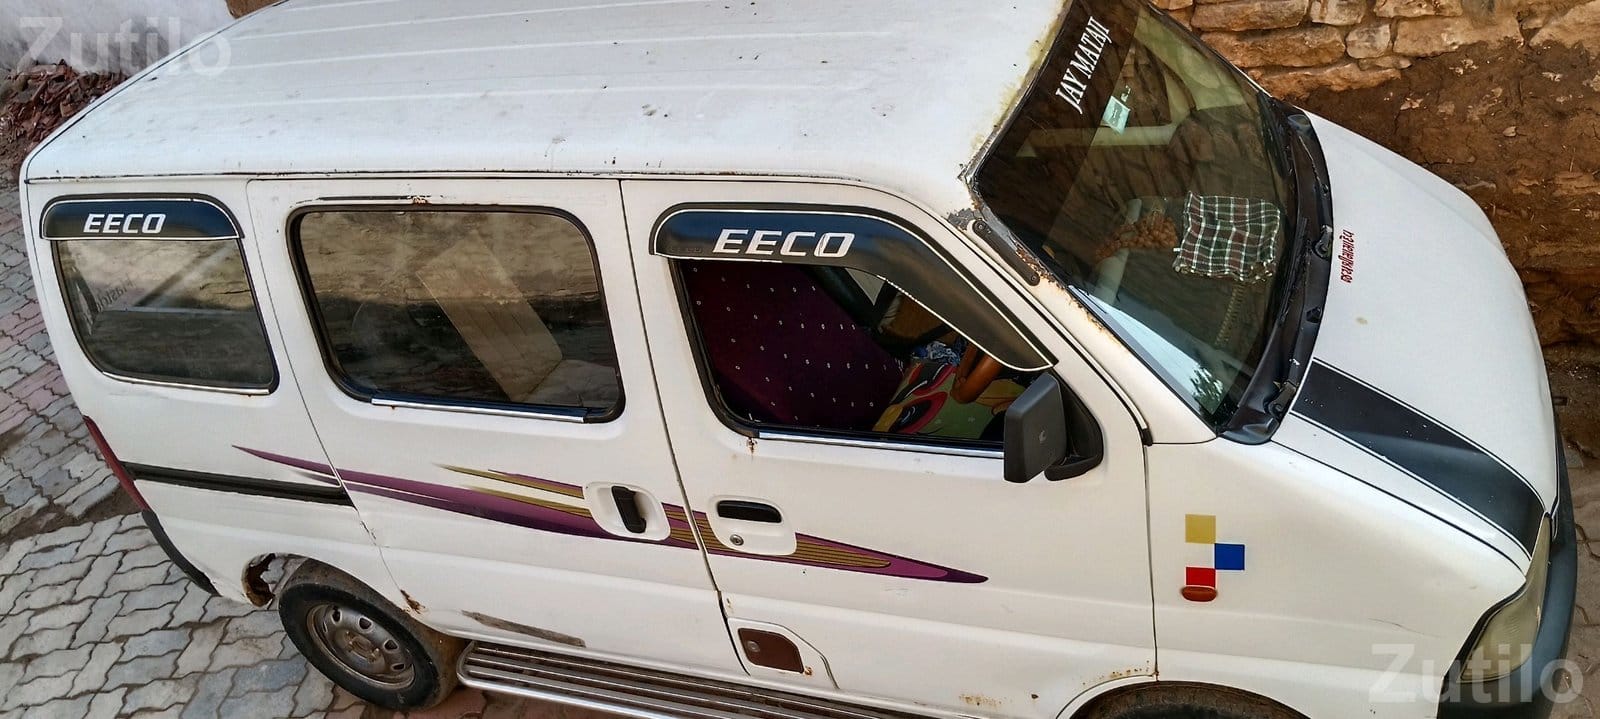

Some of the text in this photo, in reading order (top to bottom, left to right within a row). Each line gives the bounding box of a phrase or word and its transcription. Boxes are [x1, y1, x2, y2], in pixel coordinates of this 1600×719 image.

[1055, 16, 1112, 115] JAY MATAJI
[83, 213, 166, 234] EECO
[712, 228, 855, 258] EECO
